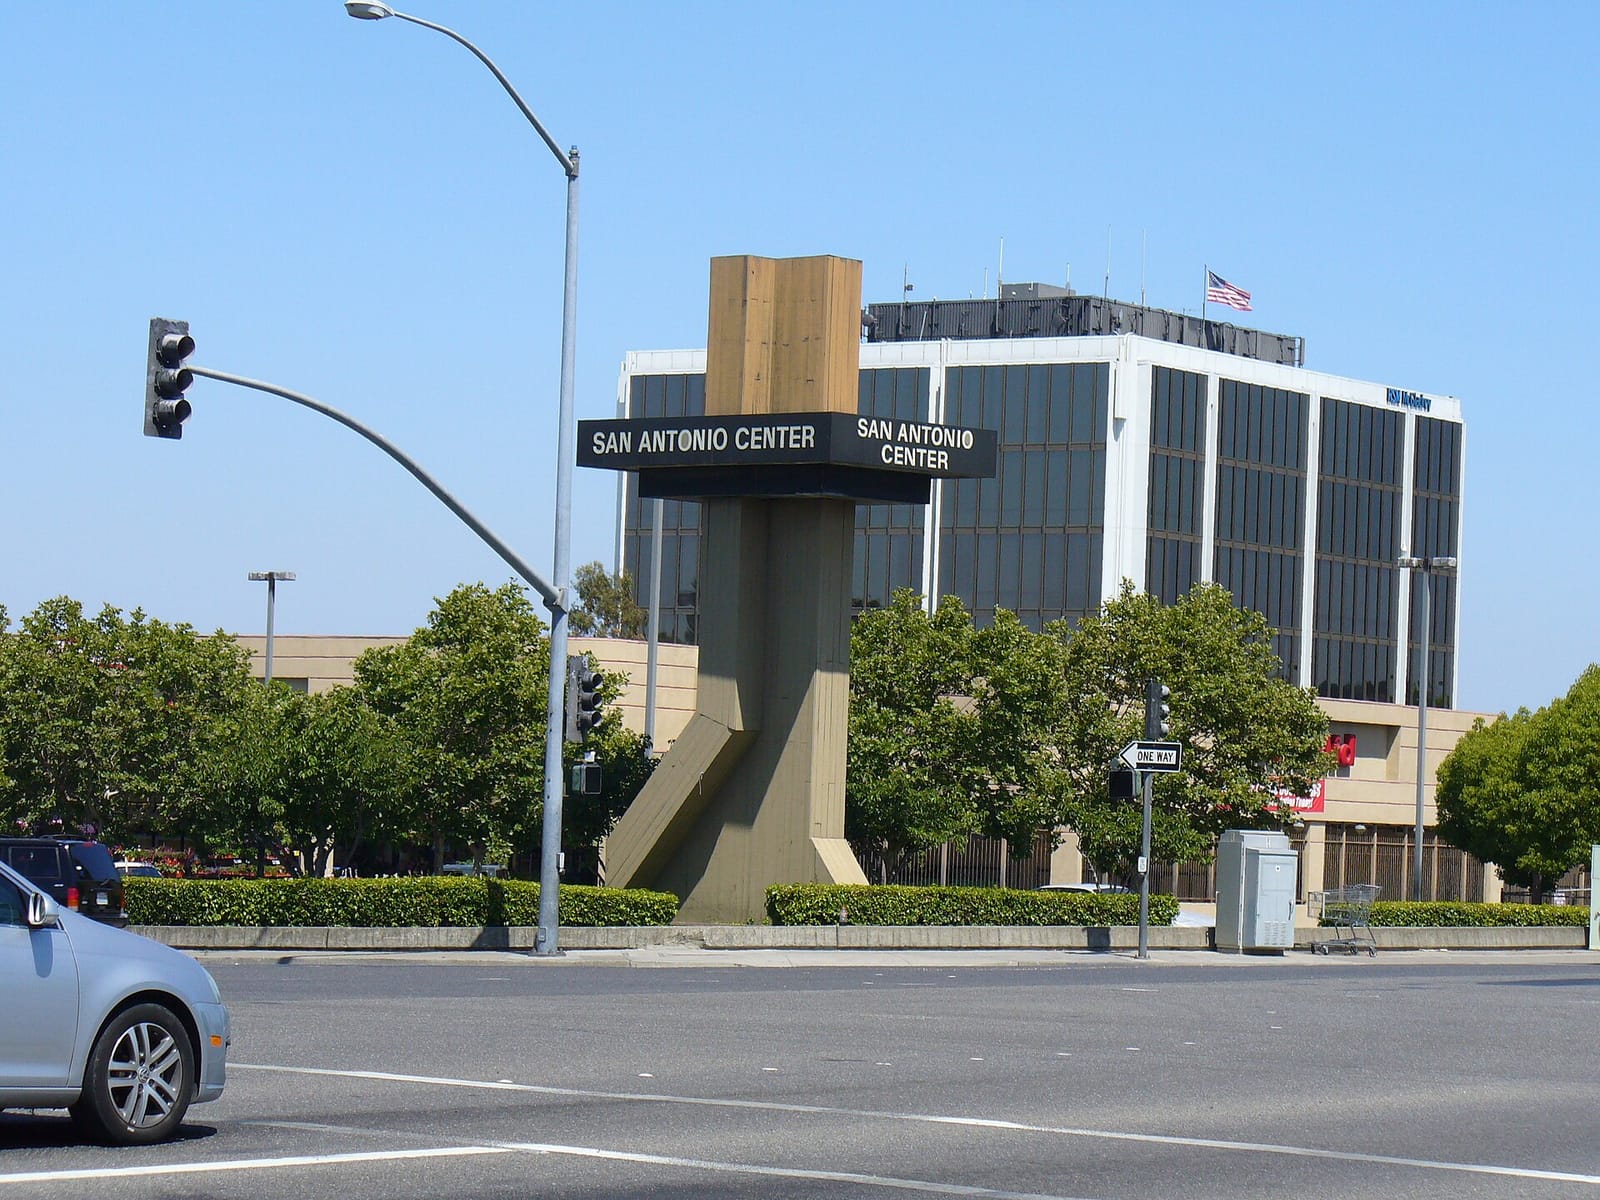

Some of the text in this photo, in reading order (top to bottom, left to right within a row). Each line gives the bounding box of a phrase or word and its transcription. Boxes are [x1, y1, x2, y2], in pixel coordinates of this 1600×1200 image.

[592, 425, 815, 455] SAN ANTONIO CENTER
[857, 418, 974, 450] SAN ANTONIO
[881, 444, 949, 471] CENTER
[1137, 751, 1174, 763] ONE WAY
